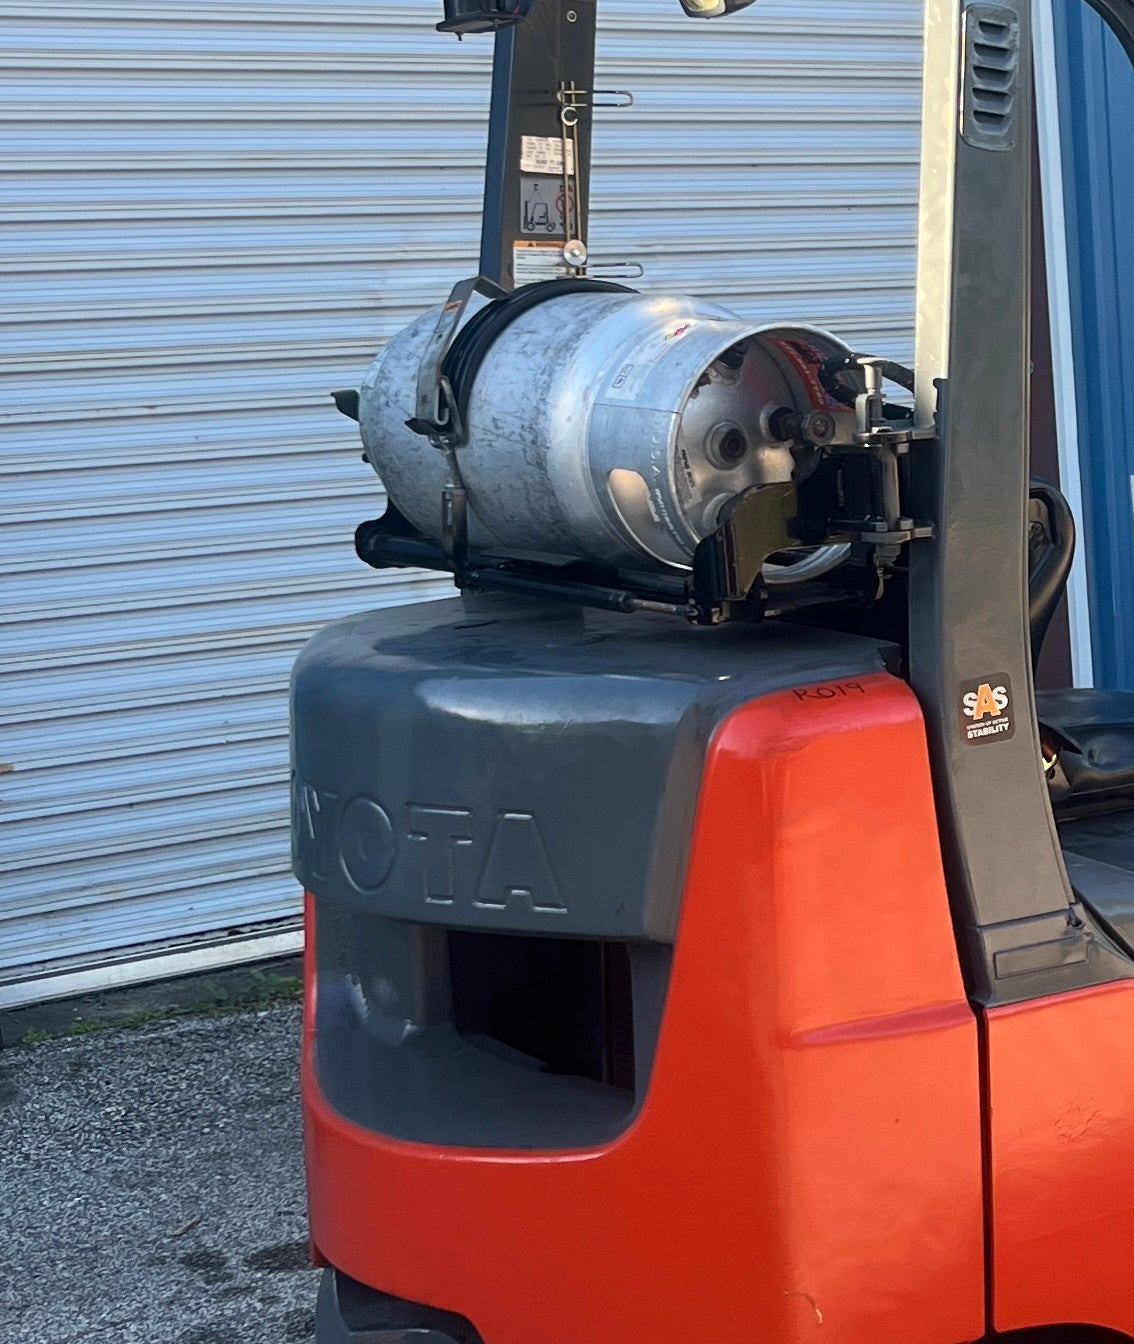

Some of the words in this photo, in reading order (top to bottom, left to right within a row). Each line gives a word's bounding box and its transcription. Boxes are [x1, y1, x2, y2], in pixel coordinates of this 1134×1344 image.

[962, 683, 1009, 721] SAS
[967, 722, 1010, 739] STABILITY
[300, 785, 568, 914] YOTA
